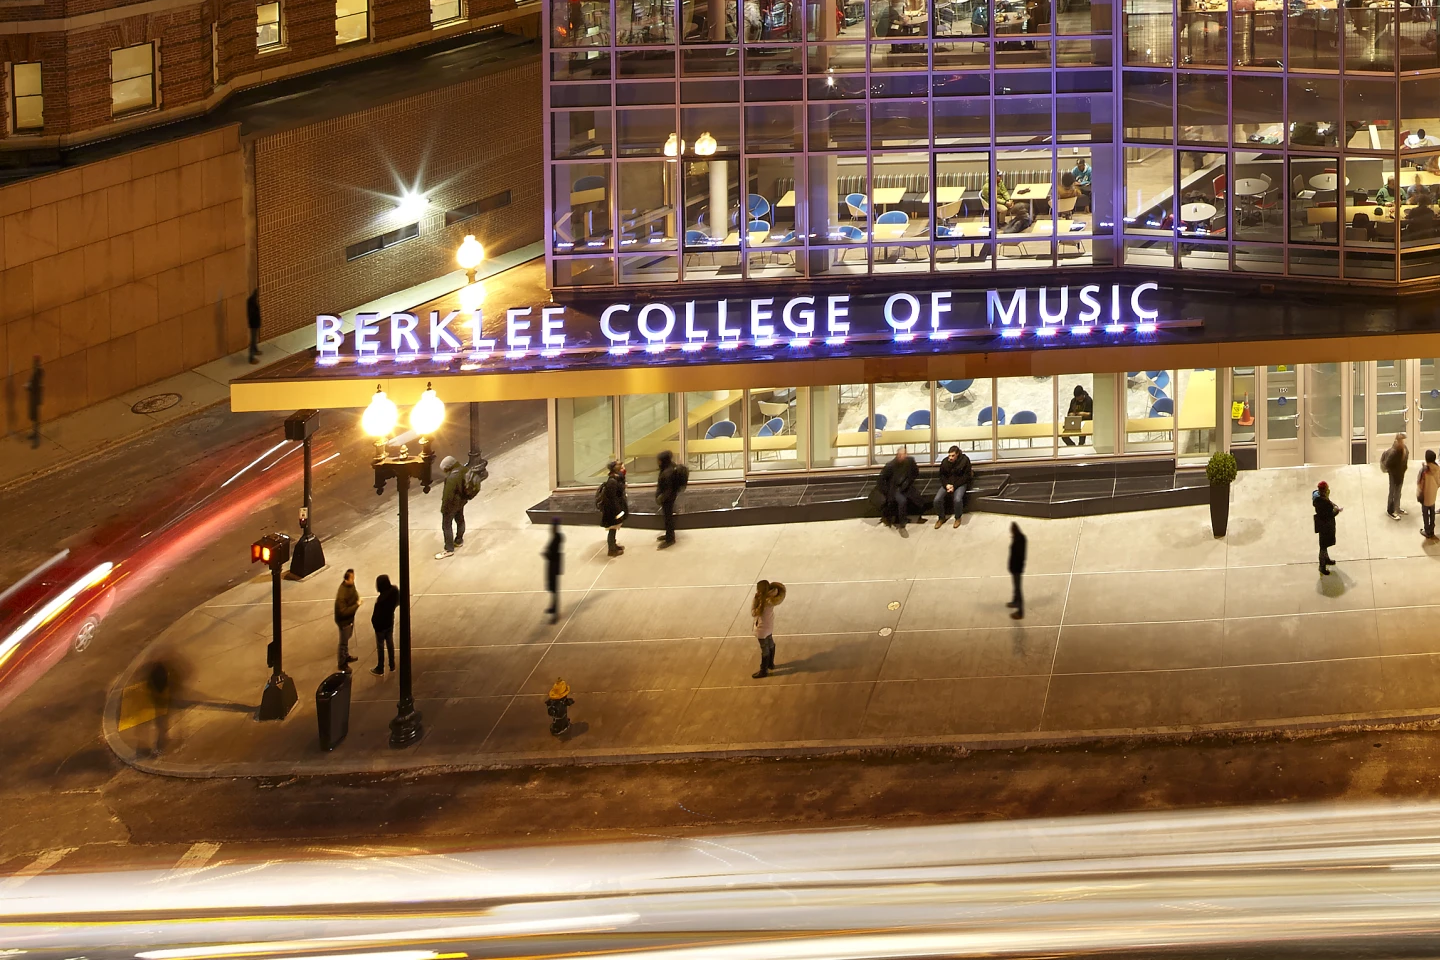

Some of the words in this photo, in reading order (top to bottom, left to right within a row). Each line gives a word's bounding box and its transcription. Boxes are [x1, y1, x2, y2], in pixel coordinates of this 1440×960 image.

[316, 306, 567, 352] BERKLEE
[600, 294, 850, 341] COLLEGE
[884, 291, 951, 329] OF
[986, 283, 1159, 325] MUSIC
